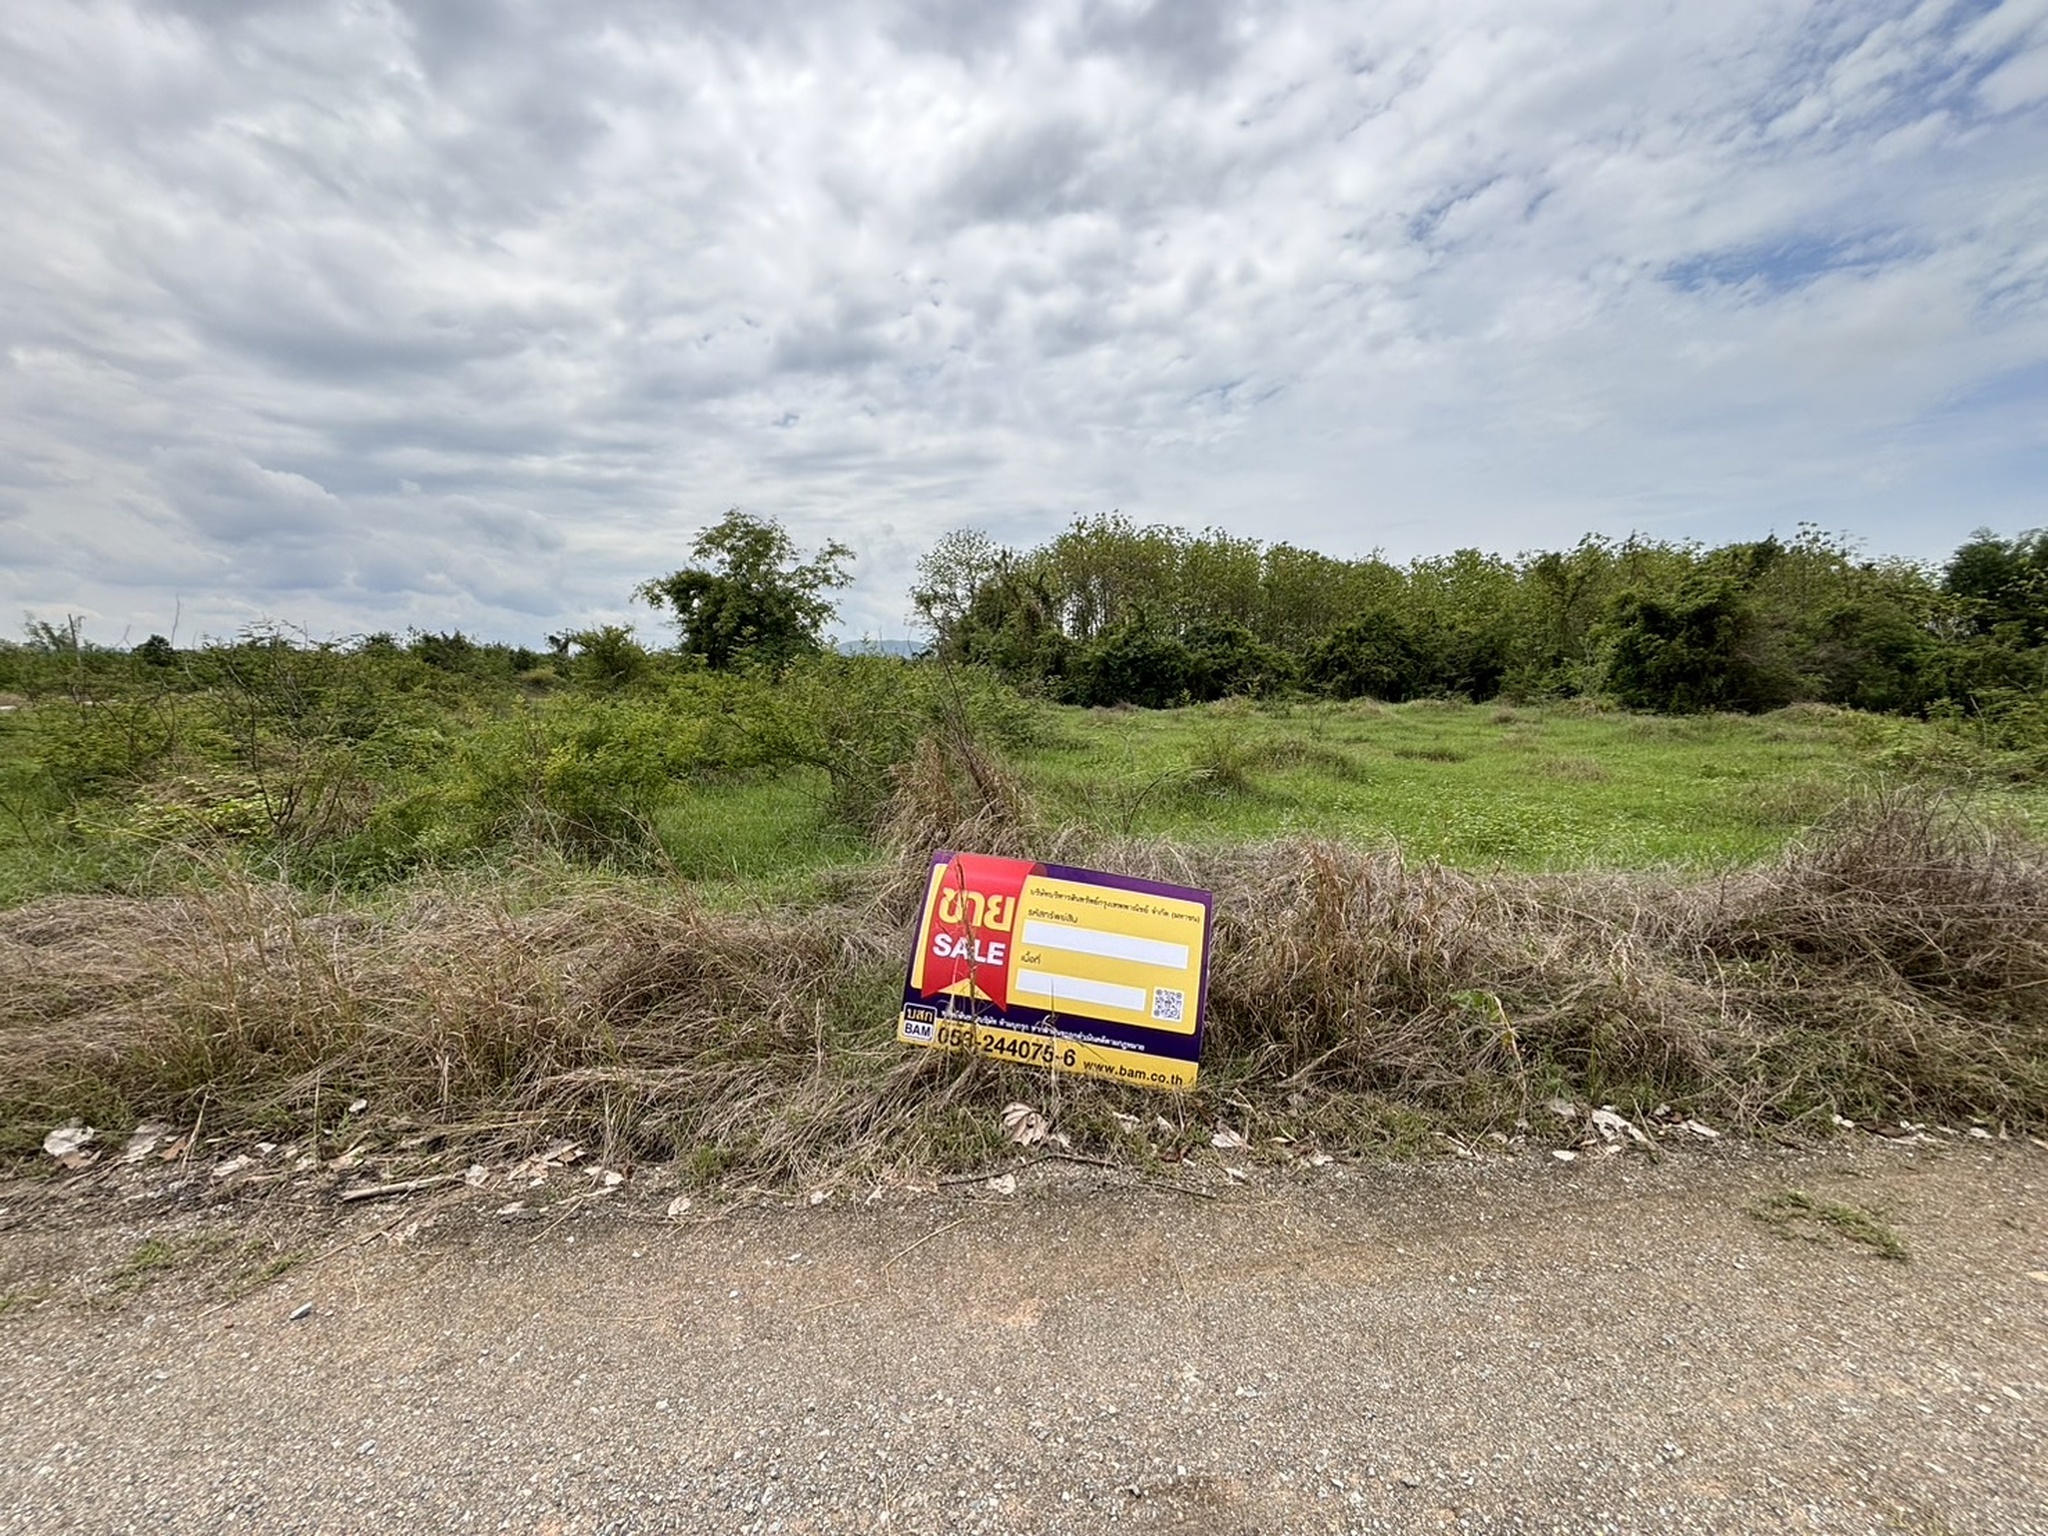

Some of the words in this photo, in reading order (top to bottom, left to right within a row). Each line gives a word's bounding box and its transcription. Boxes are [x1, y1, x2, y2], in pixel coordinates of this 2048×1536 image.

[938, 887, 1016, 932] ขาย
[932, 933, 1006, 966] SALE
[906, 1007, 933, 1022] บสก
[904, 1022, 931, 1037] BAM
[1083, 1060, 1184, 1086] www.bam.co.th
